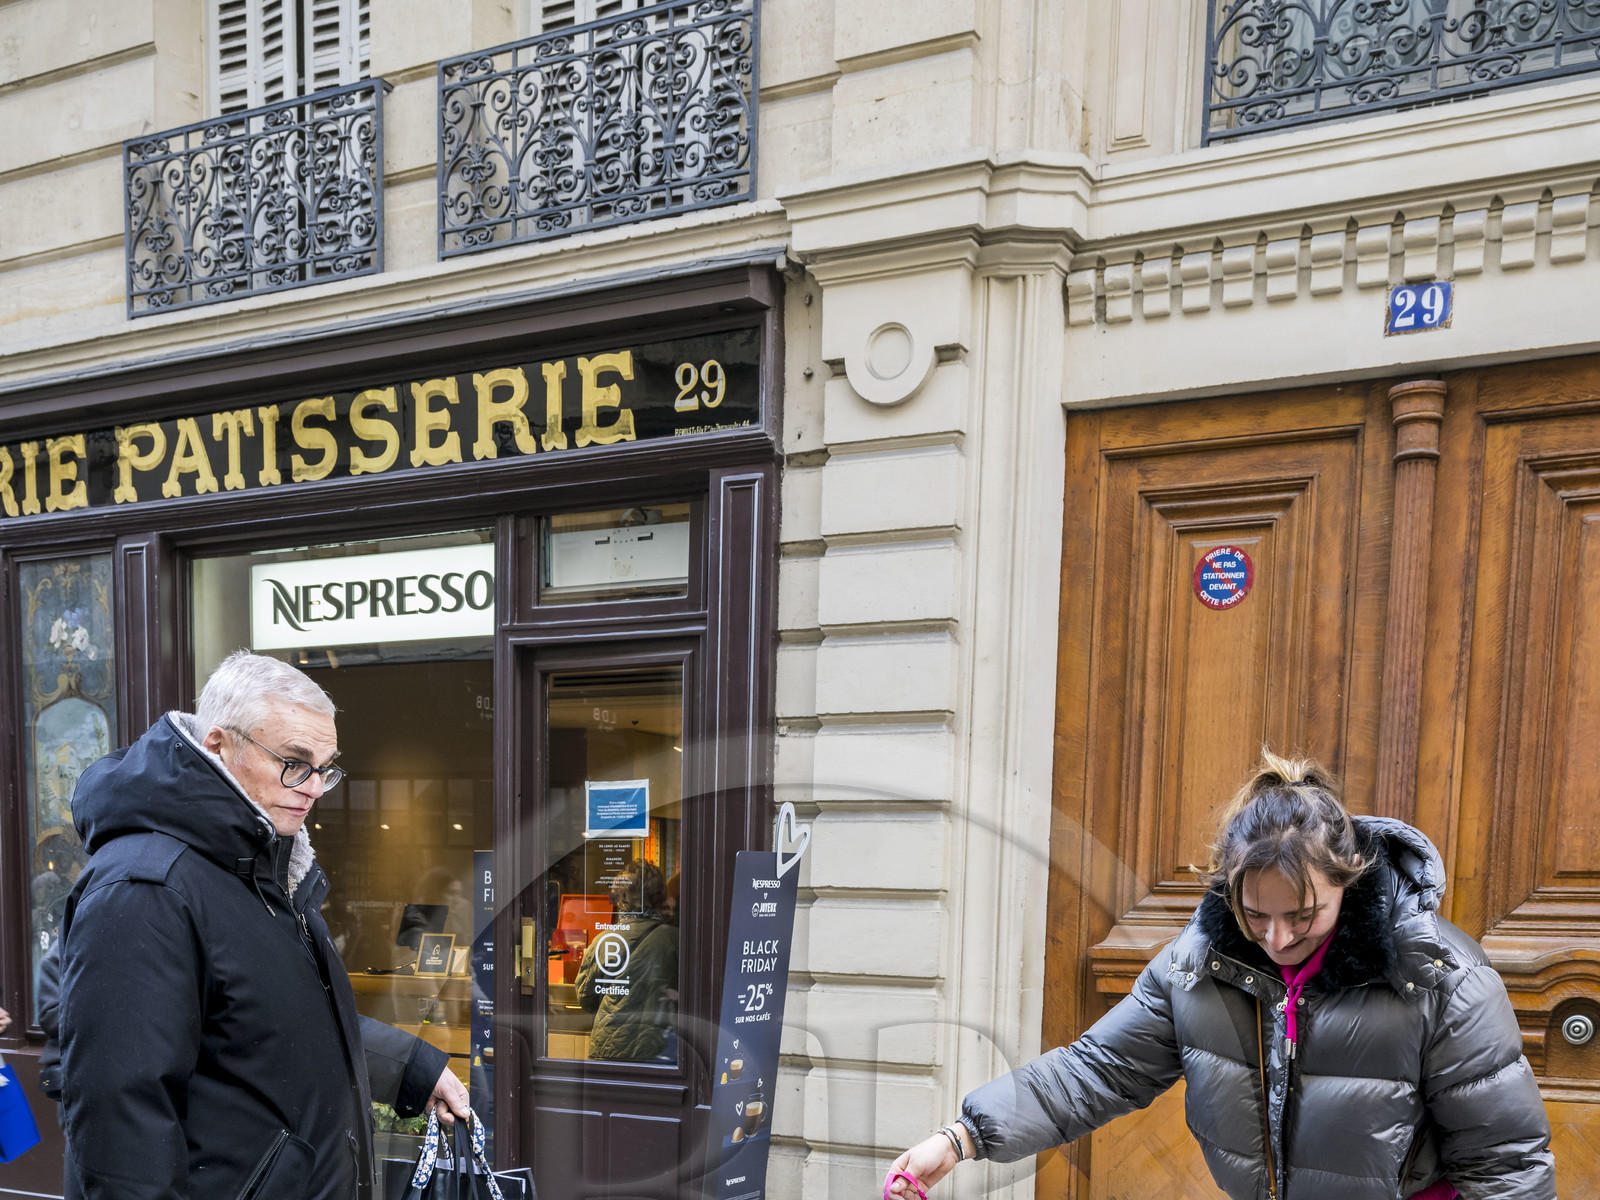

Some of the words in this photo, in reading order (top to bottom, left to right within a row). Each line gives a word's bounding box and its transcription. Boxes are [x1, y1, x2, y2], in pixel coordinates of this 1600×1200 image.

[1394, 286, 1444, 328] 29
[674, 359, 726, 413] 29
[114, 350, 636, 504] PATISSERIE
[1205, 548, 1231, 562] PRIERE
[1234, 551, 1244, 561] DE
[261, 570, 494, 632] NESPRESSO
[1200, 590, 1219, 605] CETTE
[1222, 590, 1244, 605] PORTE
[752, 878, 781, 889] NESPRESSO
[595, 922, 630, 931] Entreprise
[604, 941, 621, 967] B
[743, 940, 779, 955] BLACK
[741, 957, 777, 973] FRIDAY
[595, 984, 630, 996] Certifiée
[735, 1016, 744, 1024] SUR
[745, 1014, 755, 1023] NOS
